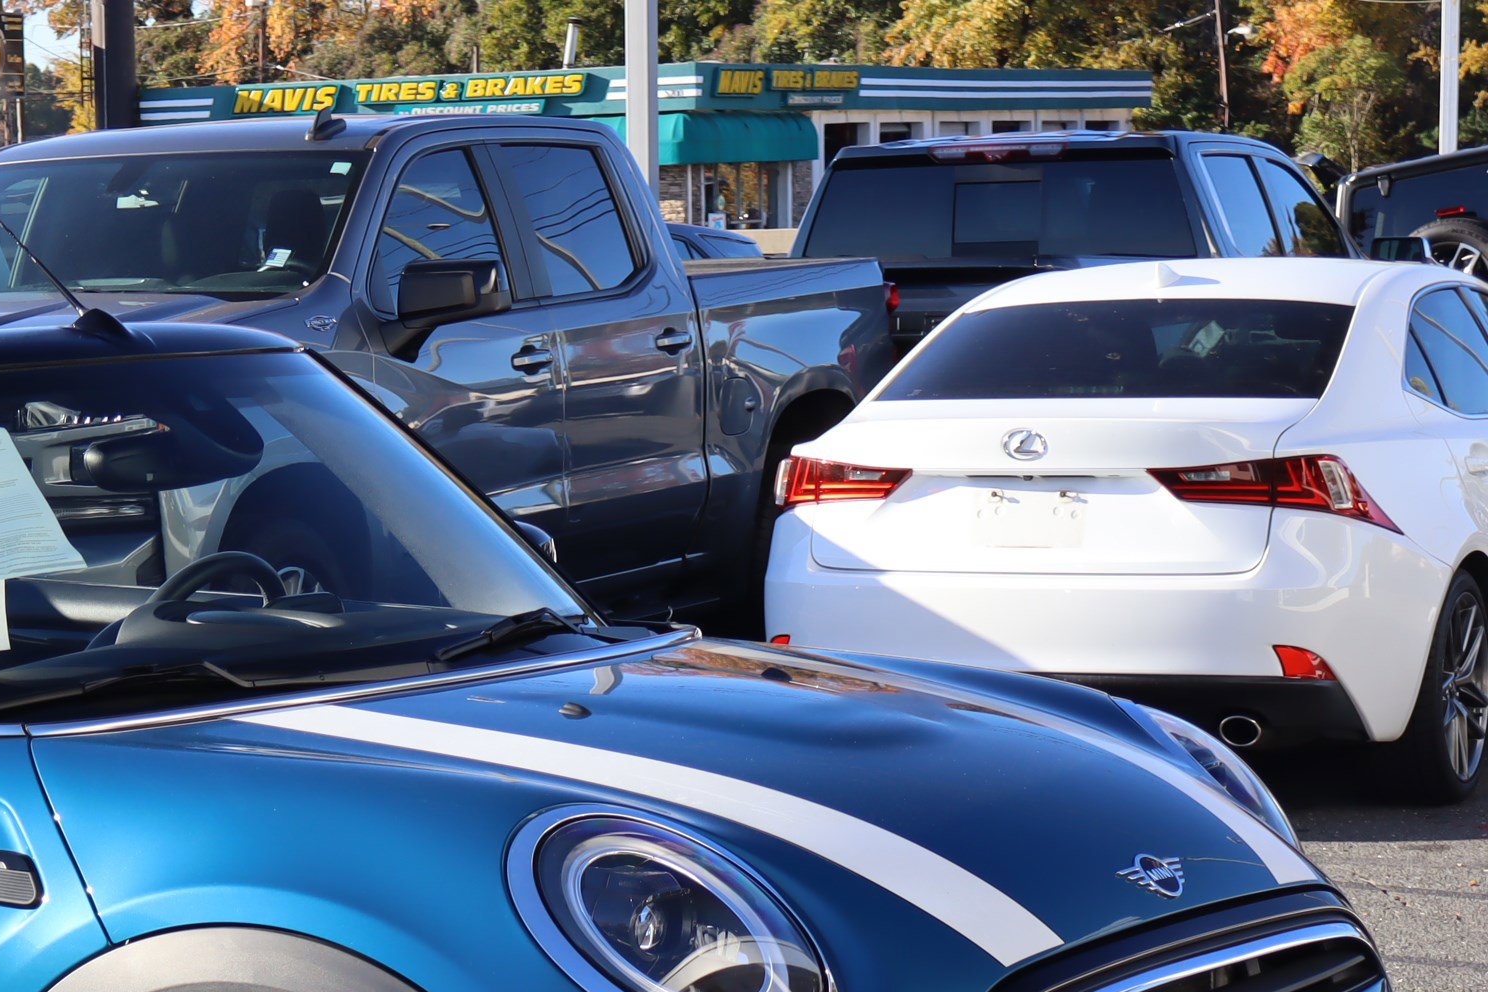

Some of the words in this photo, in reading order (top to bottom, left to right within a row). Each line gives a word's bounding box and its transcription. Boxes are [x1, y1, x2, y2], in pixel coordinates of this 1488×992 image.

[234, 86, 338, 113] MAVIS
[356, 81, 437, 102] TIRES
[440, 82, 460, 99] &
[466, 74, 584, 97] BRAKES
[718, 70, 765, 95] MAVIS
[412, 106, 483, 115] DISCOUNT
[486, 103, 540, 113] PRICES
